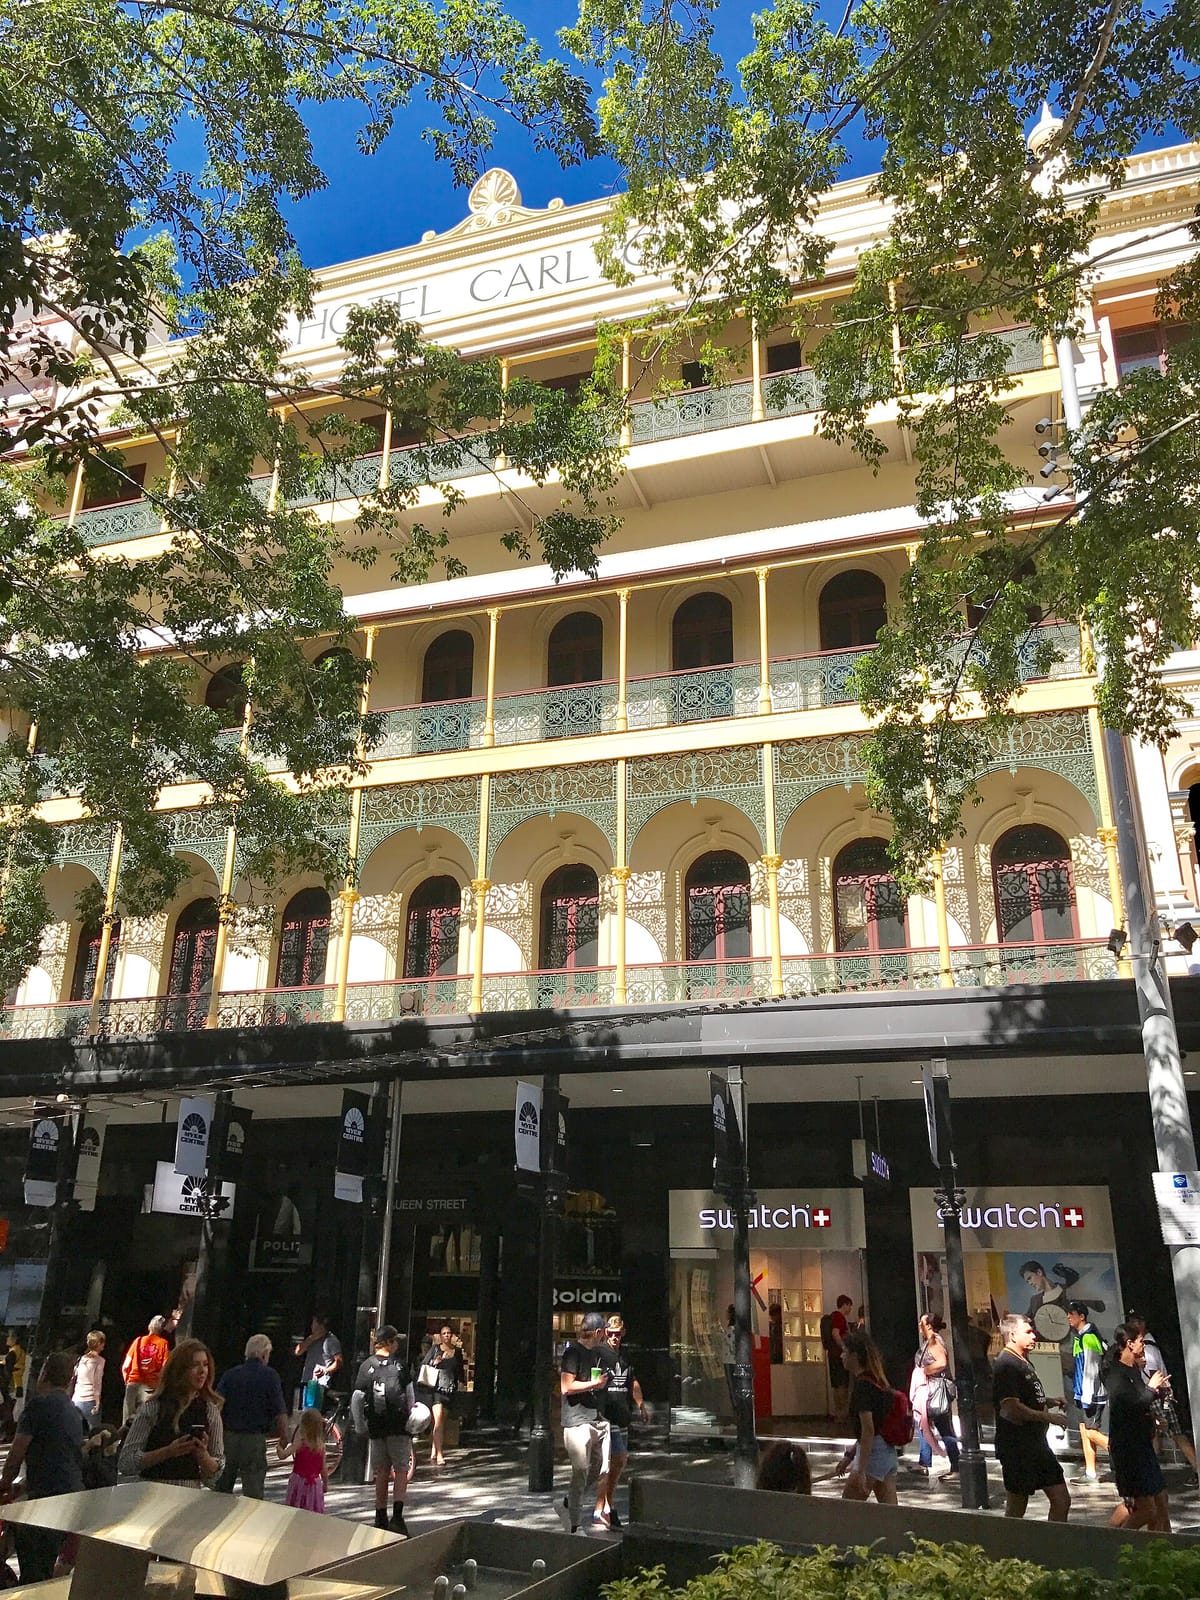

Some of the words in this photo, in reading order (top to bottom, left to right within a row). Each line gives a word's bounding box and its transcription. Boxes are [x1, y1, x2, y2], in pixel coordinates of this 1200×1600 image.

[184, 1131, 203, 1140] MYER
[342, 1132, 364, 1143] CENTRE
[181, 1136, 206, 1146] CENTRE
[180, 1204, 201, 1213] CENT
[393, 1199, 423, 1210] UEEN
[426, 1199, 467, 1210] STREET
[552, 1287, 621, 1306] oldm
